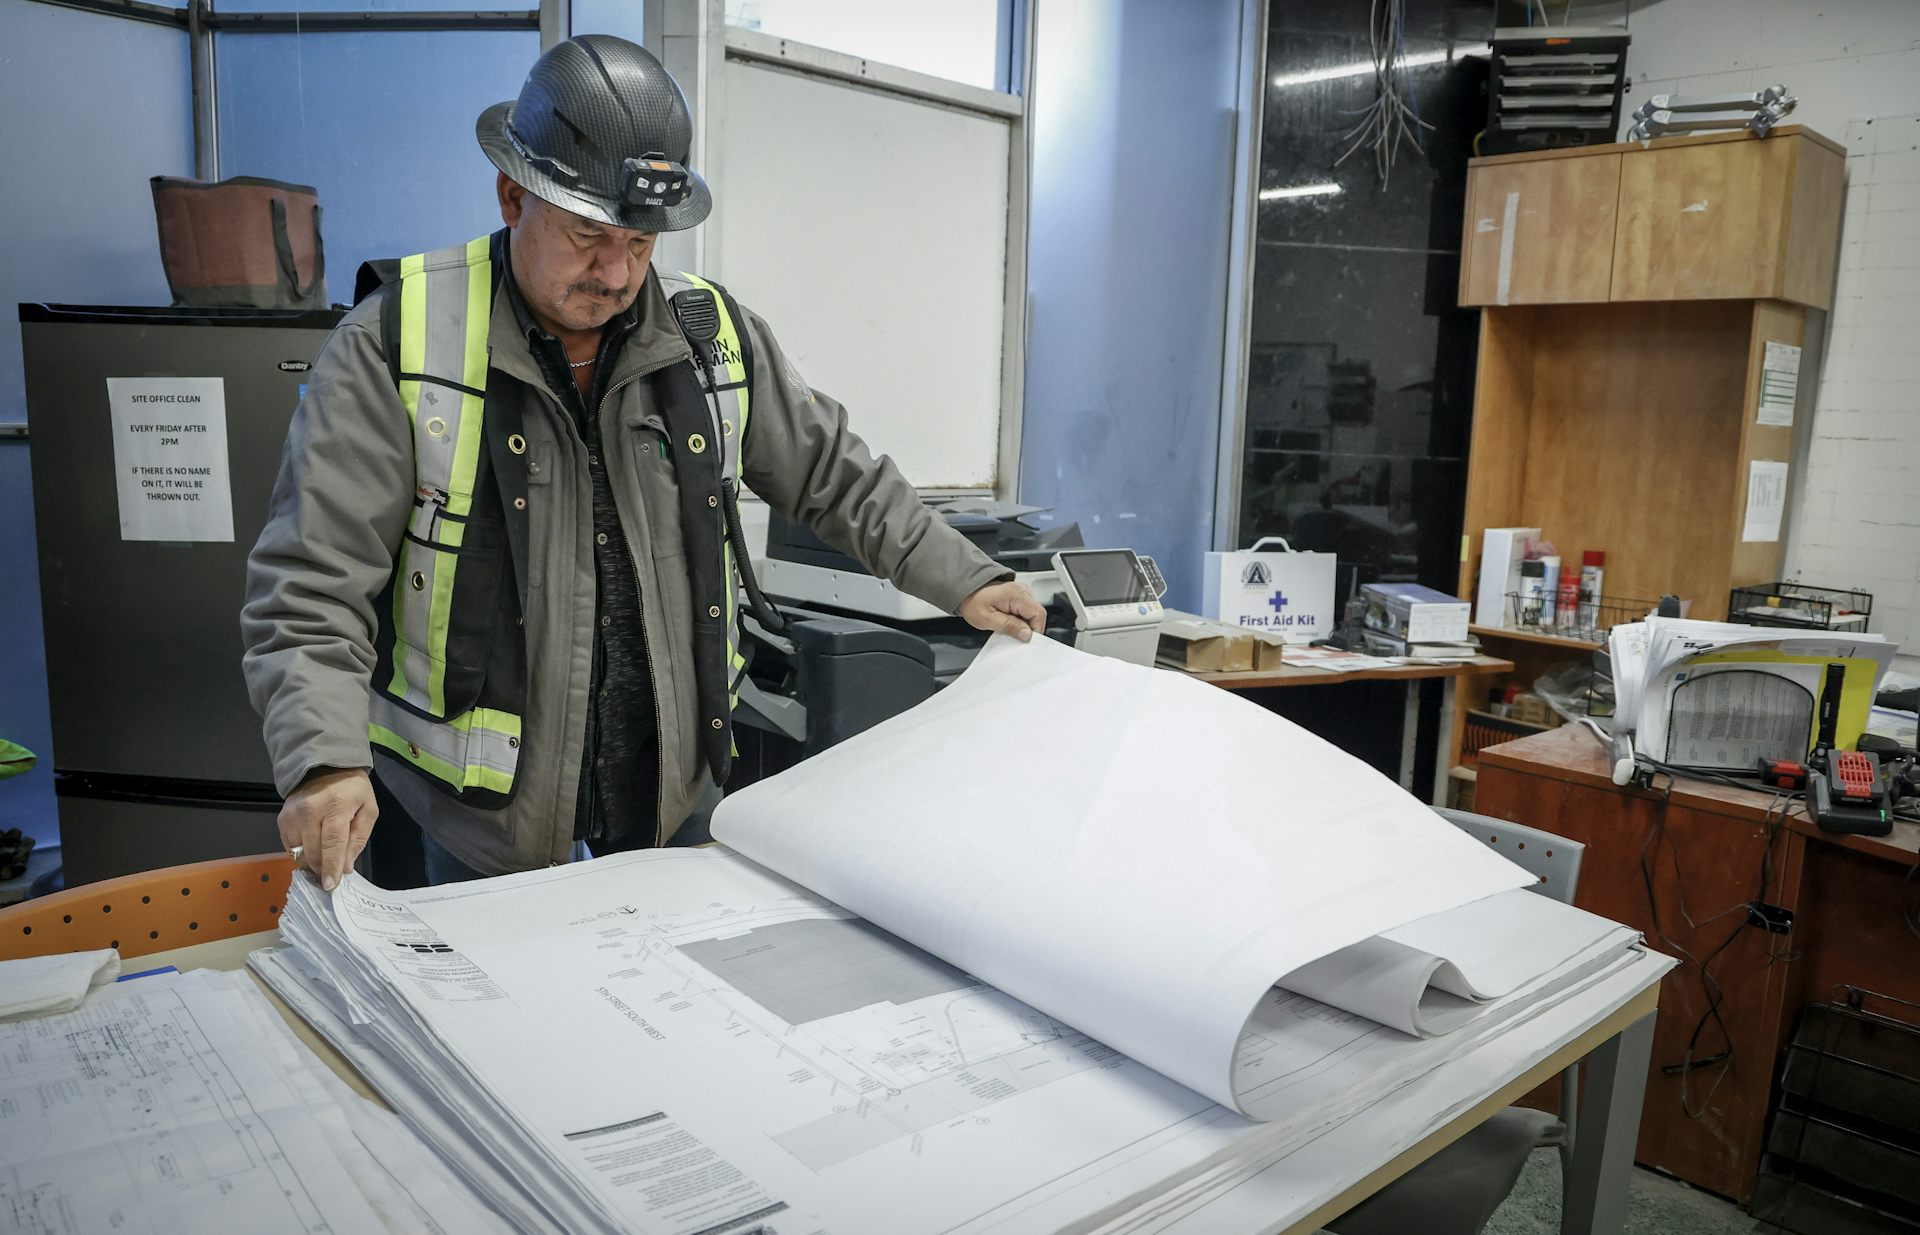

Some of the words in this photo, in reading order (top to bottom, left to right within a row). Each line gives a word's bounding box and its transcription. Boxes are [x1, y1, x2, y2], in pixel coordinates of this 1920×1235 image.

[280, 361, 310, 371] Danby
[131, 394, 148, 404] SITE
[149, 394, 175, 404] OFFICE
[177, 394, 201, 404] CLEAN
[130, 424, 154, 433] EVERY
[155, 424, 182, 433] FRIDAY
[183, 424, 207, 433] AFTER
[160, 437, 179, 446] 2PM
[132, 467, 140, 475] IF
[141, 467, 164, 475] THERE
[165, 467, 173, 475] IS
[174, 467, 187, 475] NO
[188, 467, 211, 475] NAME
[141, 479, 154, 488] ON
[155, 479, 165, 489] IT,
[165, 480, 173, 488] IT
[174, 479, 193, 488] WILL
[194, 479, 203, 488] BE
[146, 492, 182, 501] THROWN
[183, 492, 201, 501] OUT.
[1240, 615, 1268, 625] First
[1273, 615, 1293, 625] Aid
[1297, 615, 1315, 625] Kit
[595, 986, 611, 998] 5TH
[605, 995, 632, 1012] STREET
[624, 1007, 649, 1027] SOUTH
[641, 1021, 666, 1041] WEST
